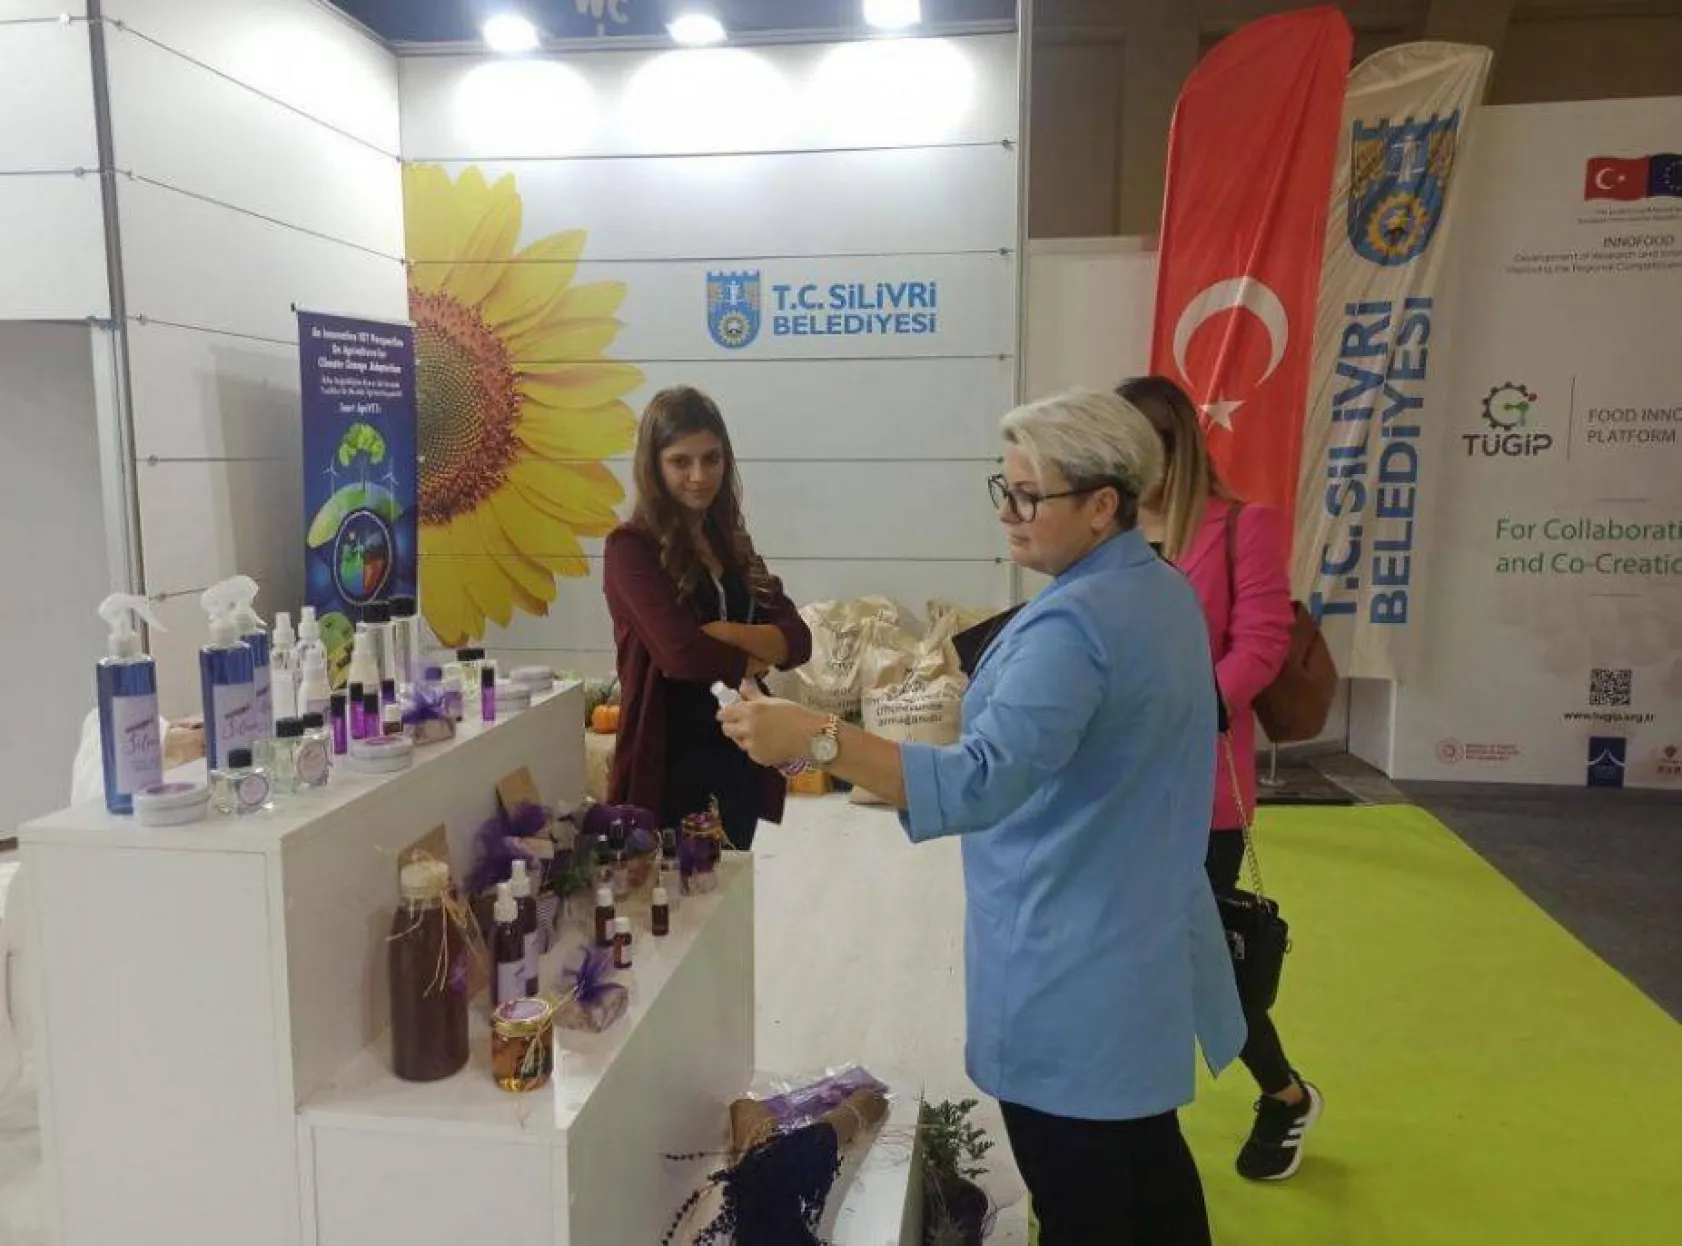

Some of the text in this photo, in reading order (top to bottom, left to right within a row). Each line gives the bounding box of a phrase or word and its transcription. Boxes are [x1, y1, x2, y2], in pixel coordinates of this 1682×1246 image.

[1603, 234, 1676, 248] INNOFOOD
[772, 283, 824, 310] T.C.
[1588, 408, 1637, 422] FOOD
[1587, 428, 1676, 443] PLATFORM
[1495, 518, 1537, 540] For
[1496, 552, 1543, 573] and
